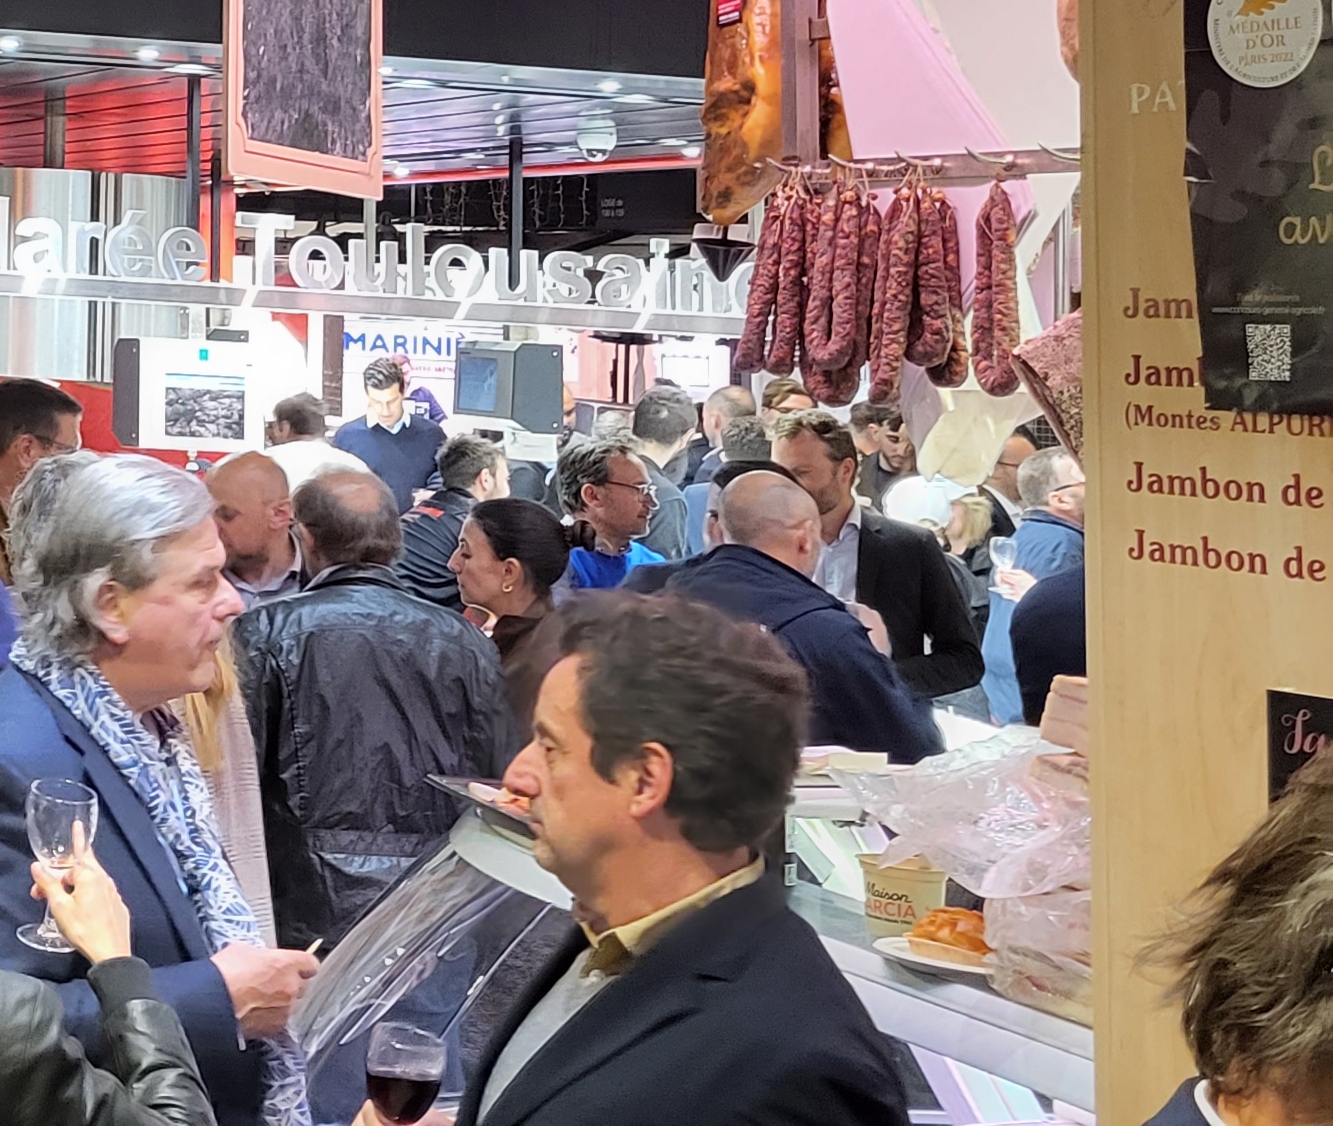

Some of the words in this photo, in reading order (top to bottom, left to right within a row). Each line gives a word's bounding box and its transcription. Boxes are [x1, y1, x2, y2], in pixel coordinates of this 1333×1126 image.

[1126, 461, 1267, 504] Jambon
[1280, 474, 1325, 508] de
[1128, 529, 1268, 575] Jambon
[1283, 546, 1327, 582] de
